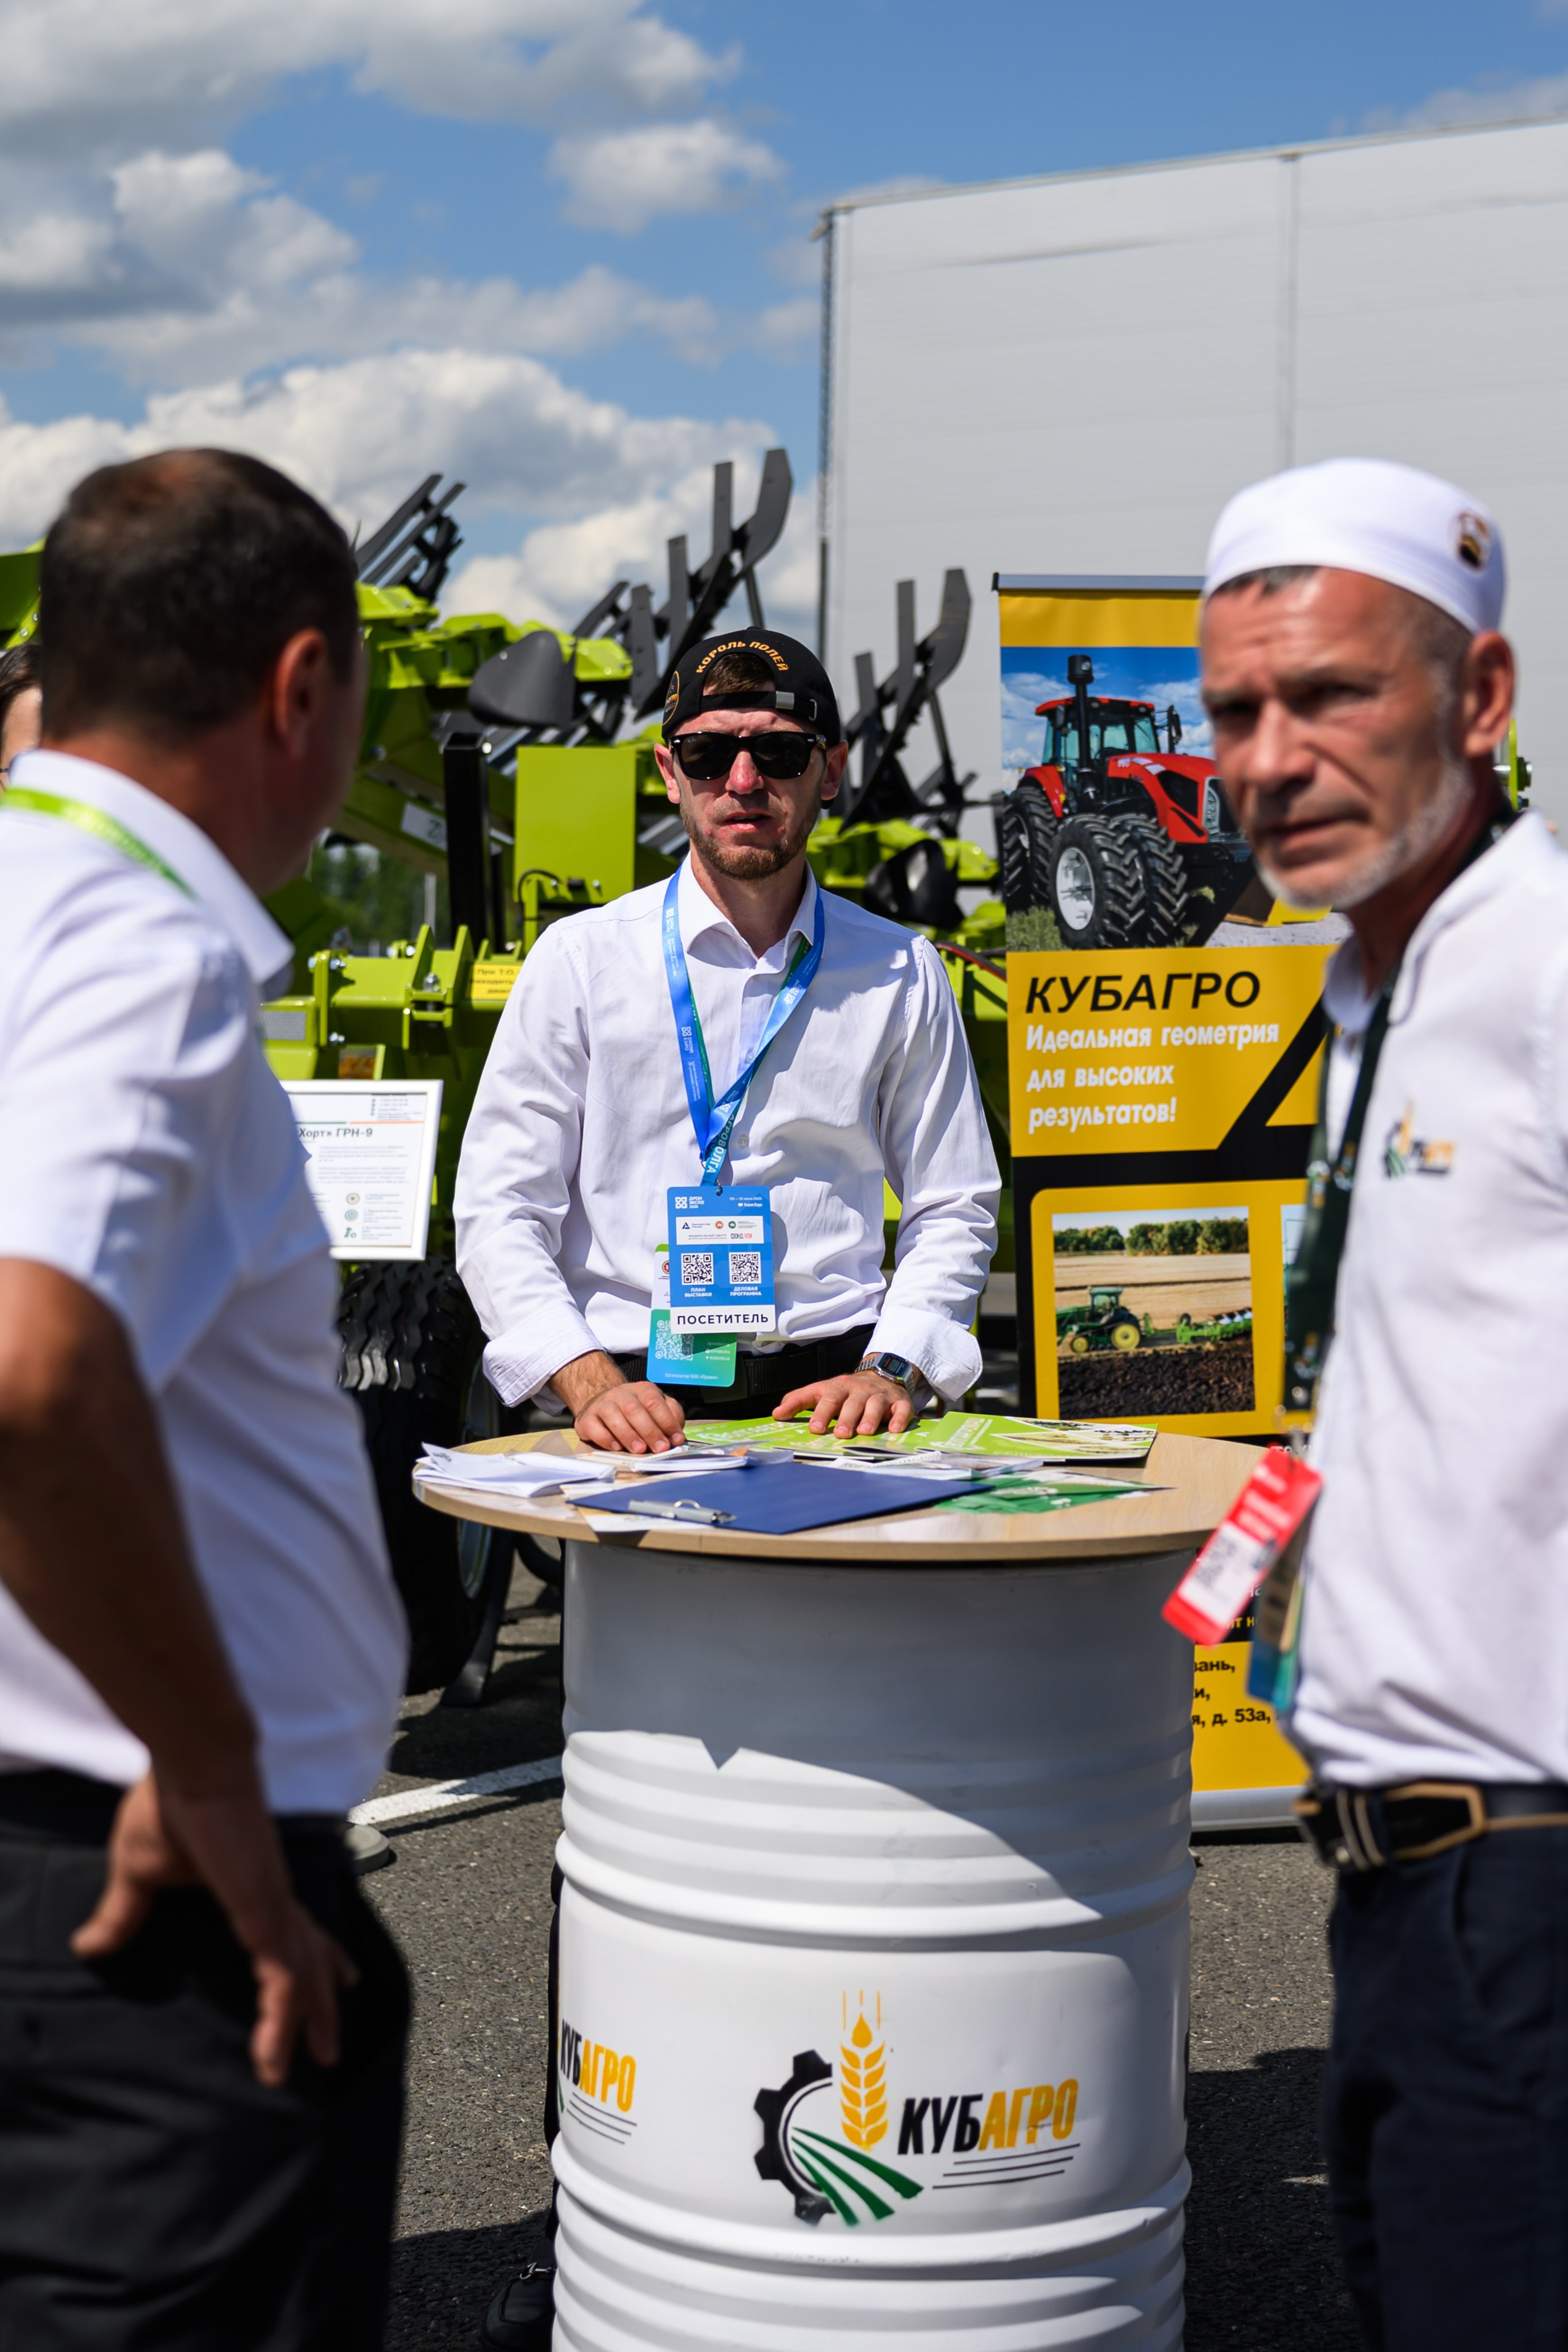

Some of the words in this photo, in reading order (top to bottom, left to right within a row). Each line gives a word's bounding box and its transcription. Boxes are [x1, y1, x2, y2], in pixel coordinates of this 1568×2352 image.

[696, 641, 745, 673] КОРОЛЬ
[750, 641, 789, 671] ПОЛЕЙ
[1025, 971, 1261, 1014] КУБАГРО
[1026, 1025, 1152, 1053] Идеальная
[1161, 1023, 1279, 1050] геометрия
[1026, 1069, 1065, 1092] для
[1074, 1065, 1175, 1088] высоких
[1028, 1097, 1177, 1134] результатов!
[336, 1128, 373, 1137] ГРН-9
[677, 1314, 769, 1325] ПОСЕТИТЕЛЬ
[1212, 1713, 1227, 1726] д.
[1235, 1708, 1271, 1723] 53а,
[560, 2018, 636, 2113] КУБАГРО
[897, 2078, 1079, 2155] КУБАГРО
